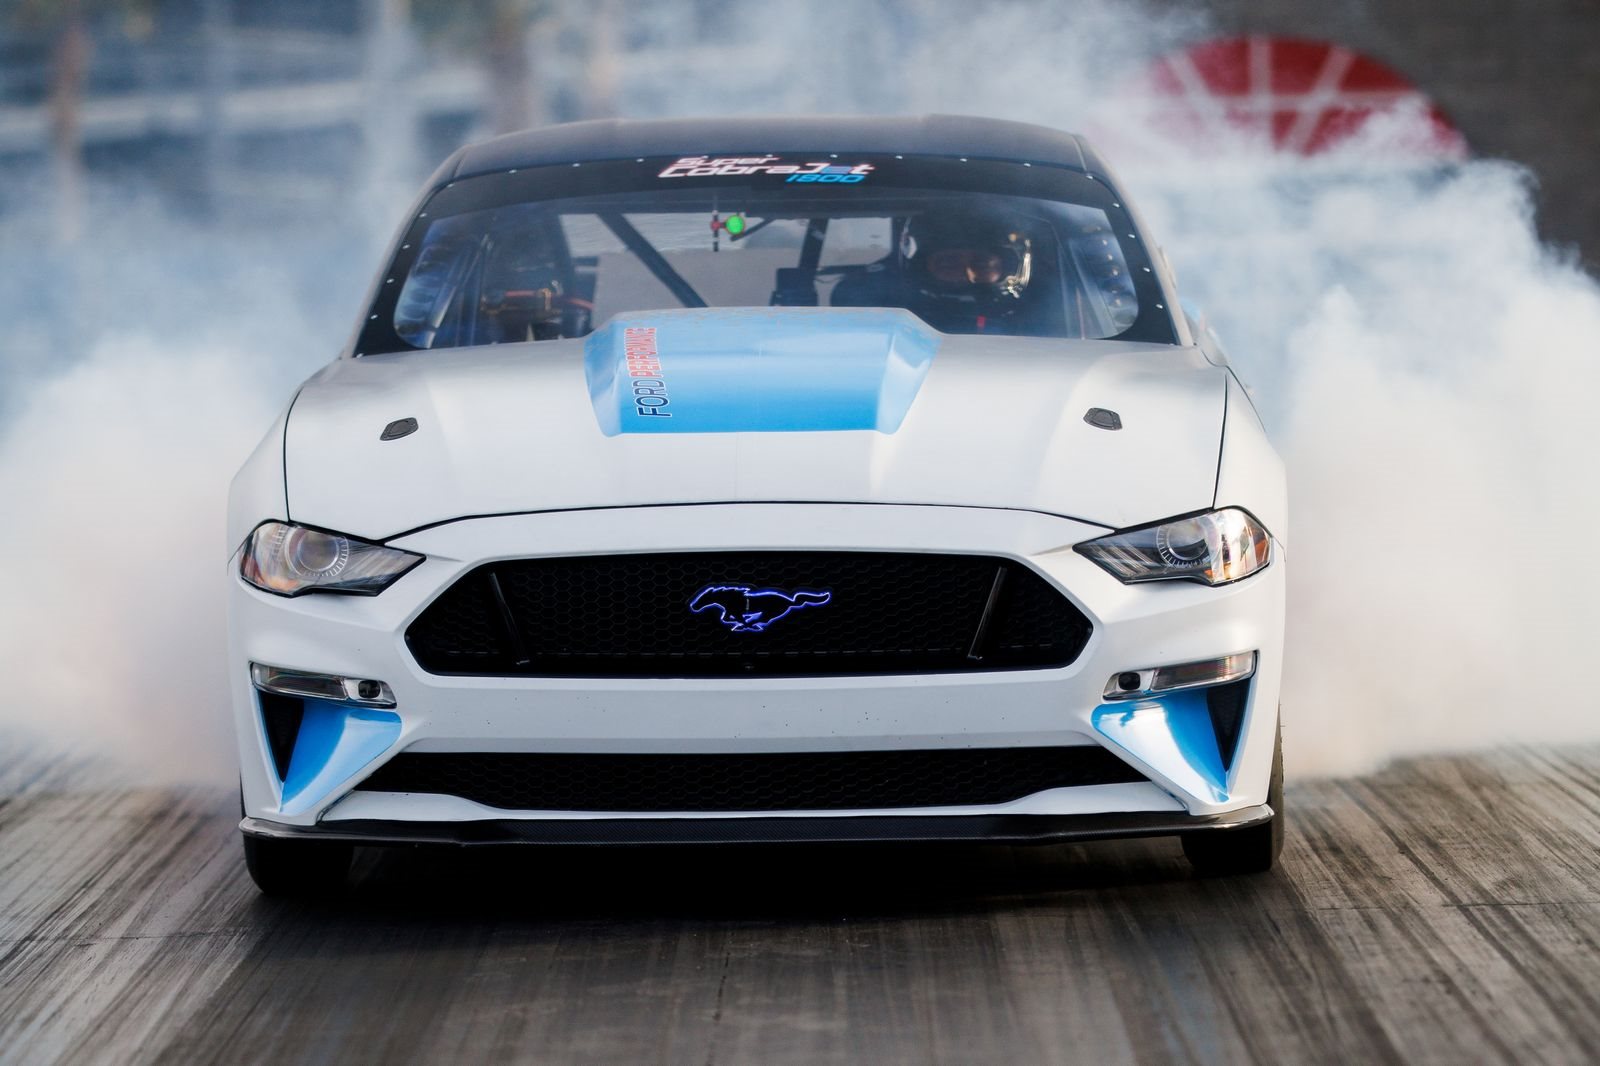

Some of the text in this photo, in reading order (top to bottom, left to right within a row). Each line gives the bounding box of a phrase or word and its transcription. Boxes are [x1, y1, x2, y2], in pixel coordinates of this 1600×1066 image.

[676, 157, 780, 167] Super
[785, 174, 865, 183] 1800
[632, 379, 672, 417] FORD
